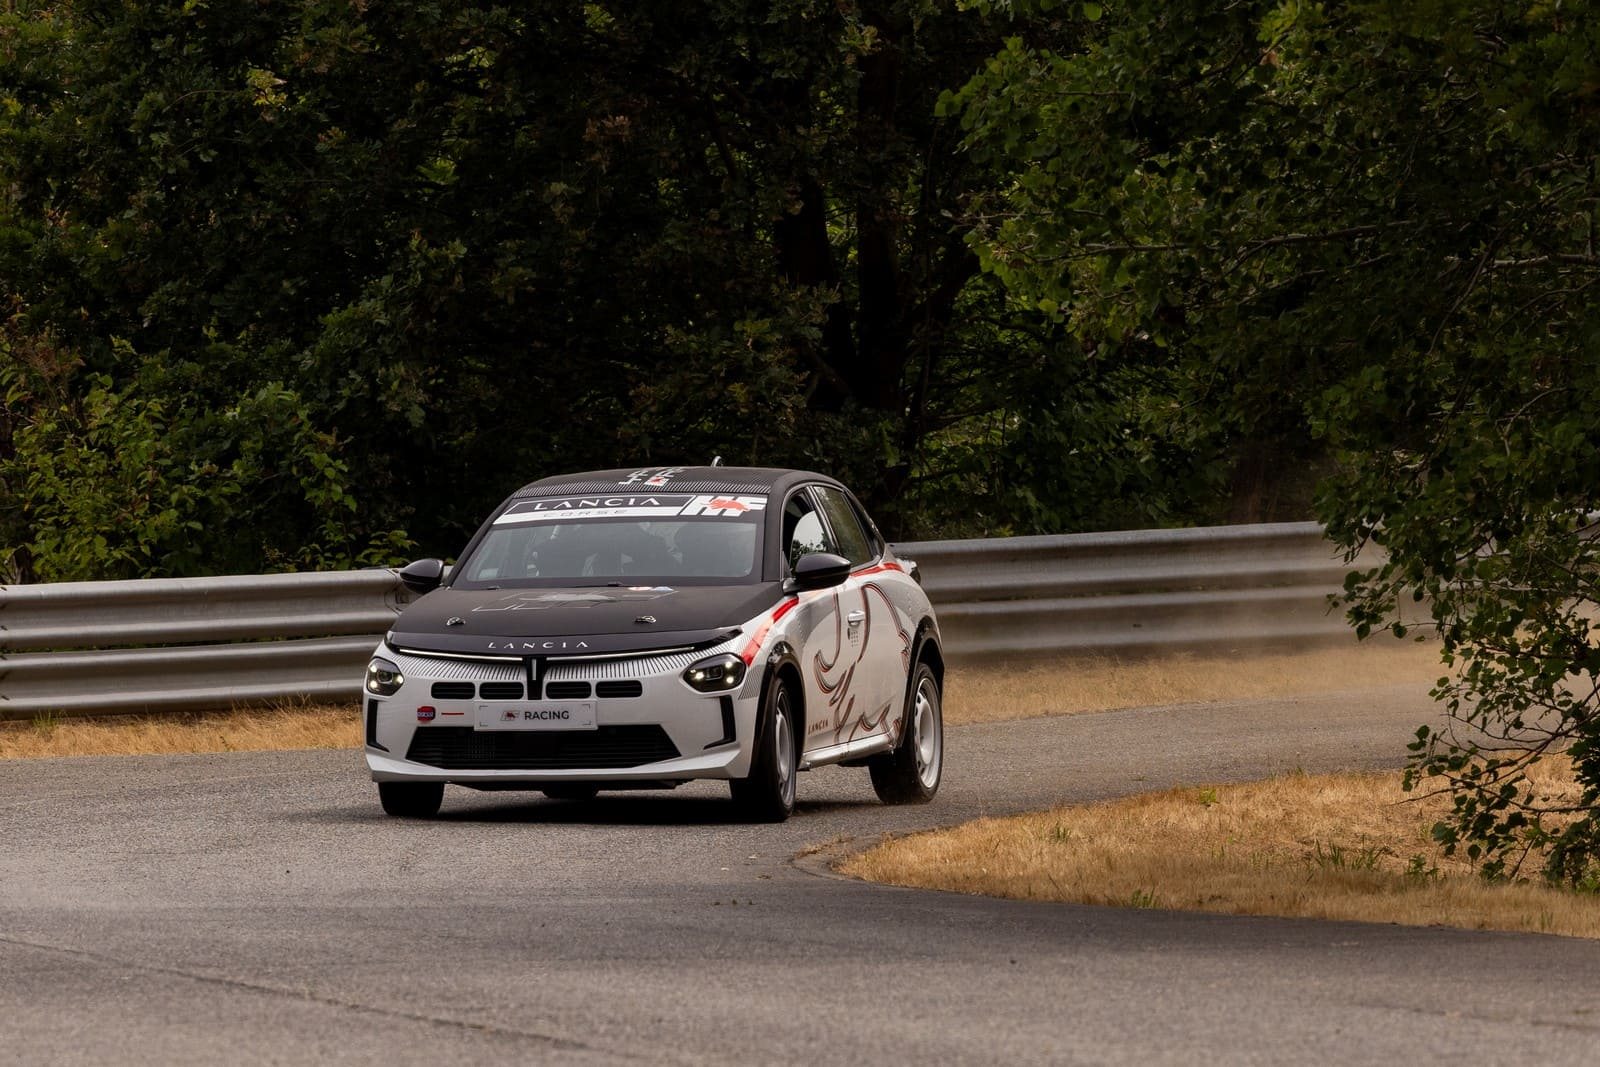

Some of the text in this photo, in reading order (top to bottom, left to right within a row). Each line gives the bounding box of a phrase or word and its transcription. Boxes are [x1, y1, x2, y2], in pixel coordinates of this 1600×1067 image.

[533, 497, 661, 511] LANCIA
[543, 508, 628, 518] CORSE
[487, 641, 589, 649] LANCIA
[524, 710, 570, 721] RACING
